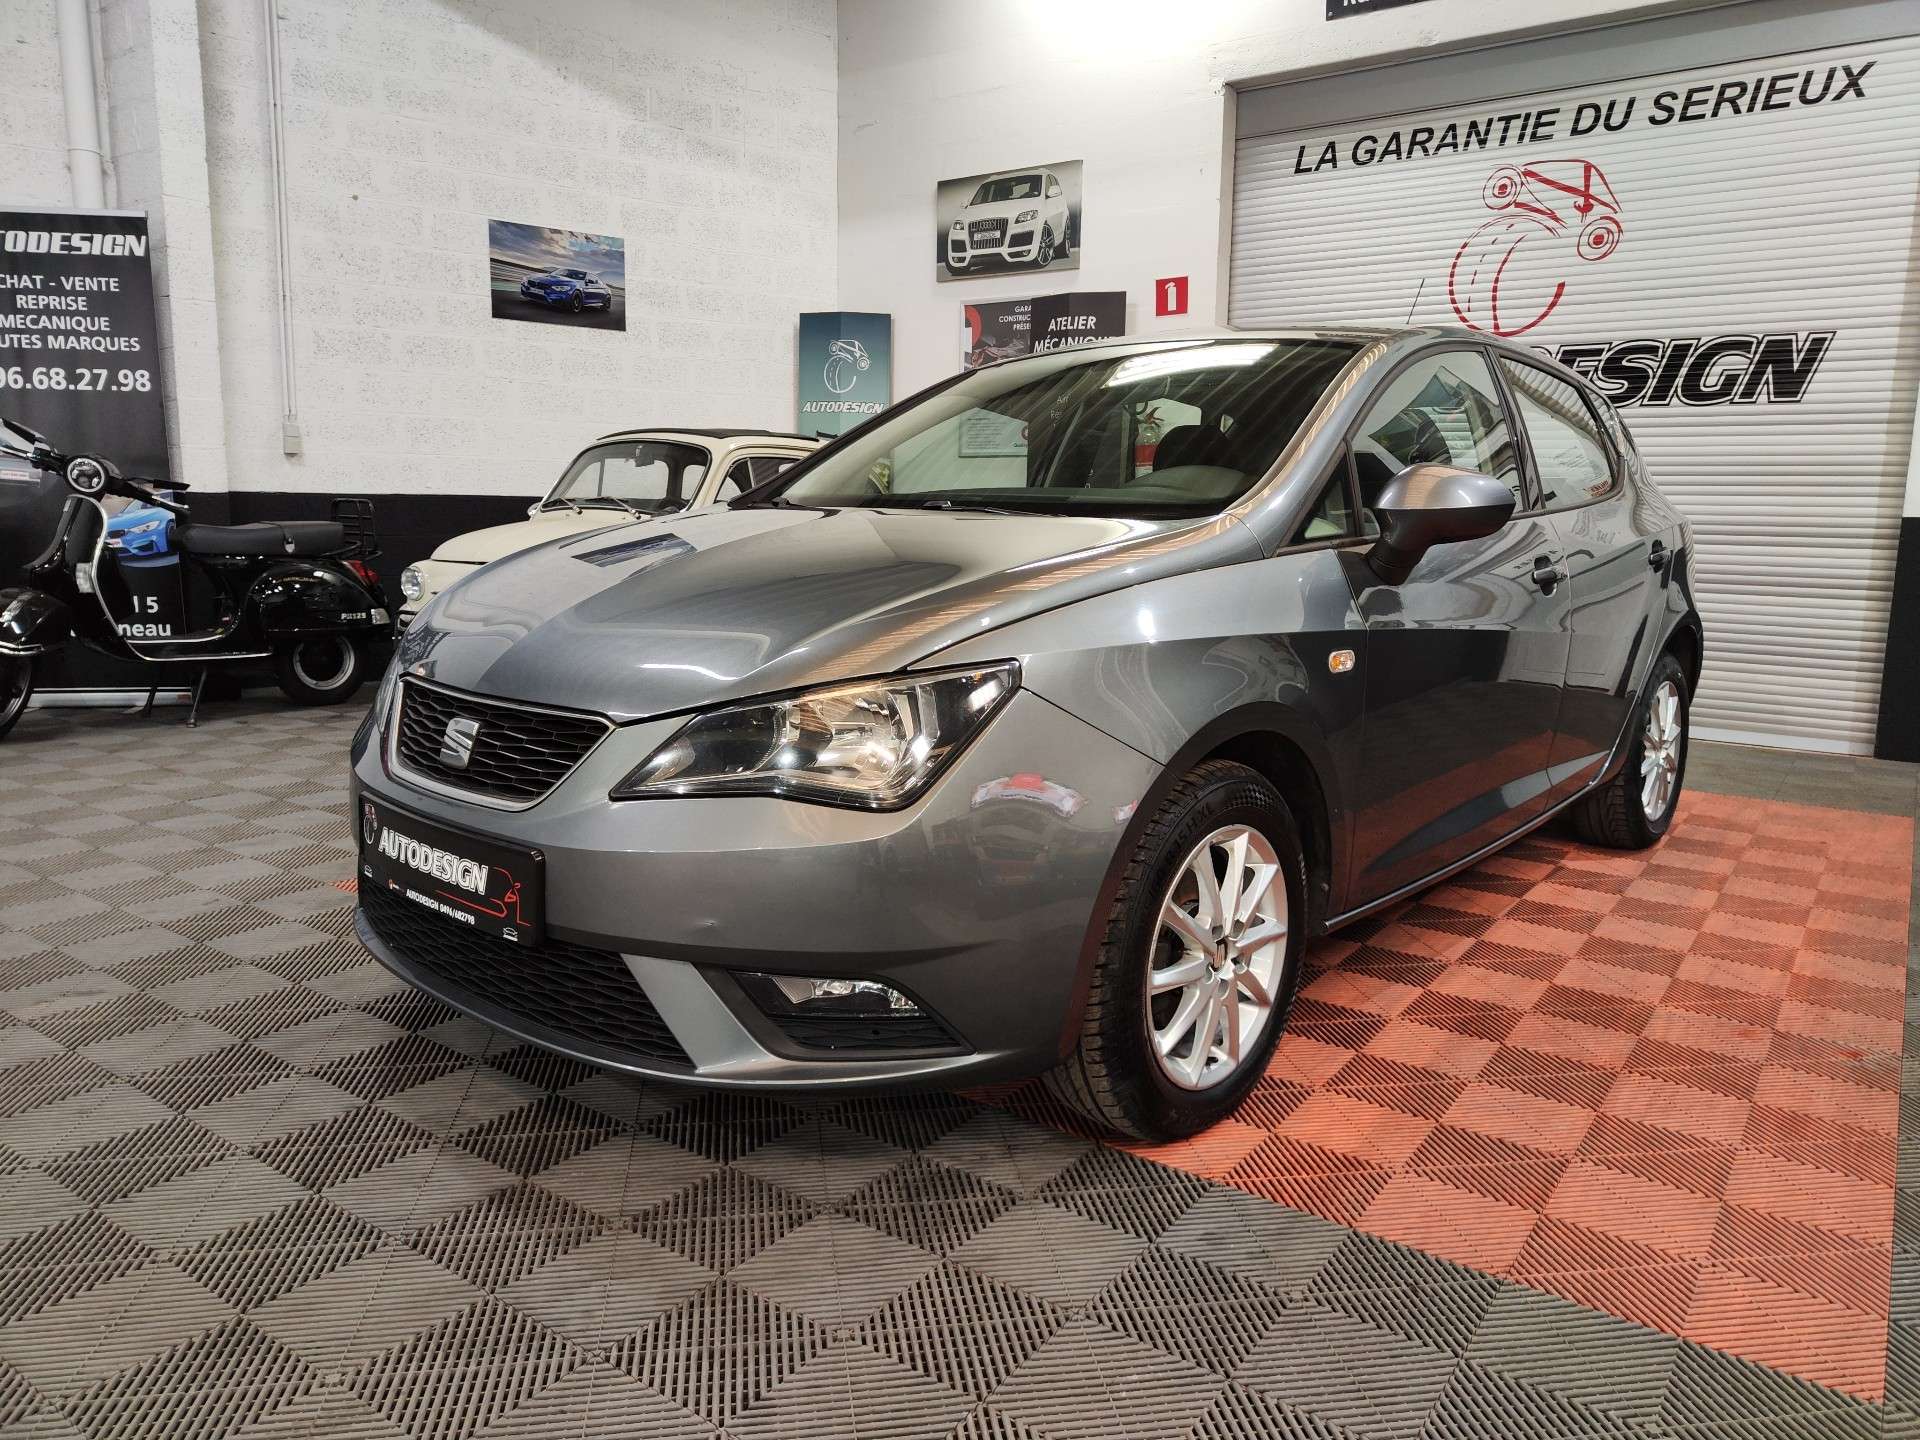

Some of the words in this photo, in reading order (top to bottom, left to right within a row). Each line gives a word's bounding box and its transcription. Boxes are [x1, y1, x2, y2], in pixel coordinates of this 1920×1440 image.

[1293, 140, 1340, 175] LA
[1350, 108, 1557, 167] GARANTIE
[1569, 97, 1638, 137] DU
[1647, 60, 1879, 124] SERIEUX
[0, 230, 147, 257] ODESIGN
[60, 275, 120, 292] VENTE
[16, 294, 88, 311] REPRISE
[0, 314, 110, 332] MECANIQUE
[1048, 316, 1096, 332] ATELIER
[47, 335, 140, 353] MARQUES
[1033, 335, 1113, 354] MÉCANI
[1529, 331, 1838, 407] ESIGN
[802, 401, 884, 414] AUTODESIGN
[377, 826, 489, 896] AUTODESIGN
[405, 888, 439, 911] AUTODESIGN
